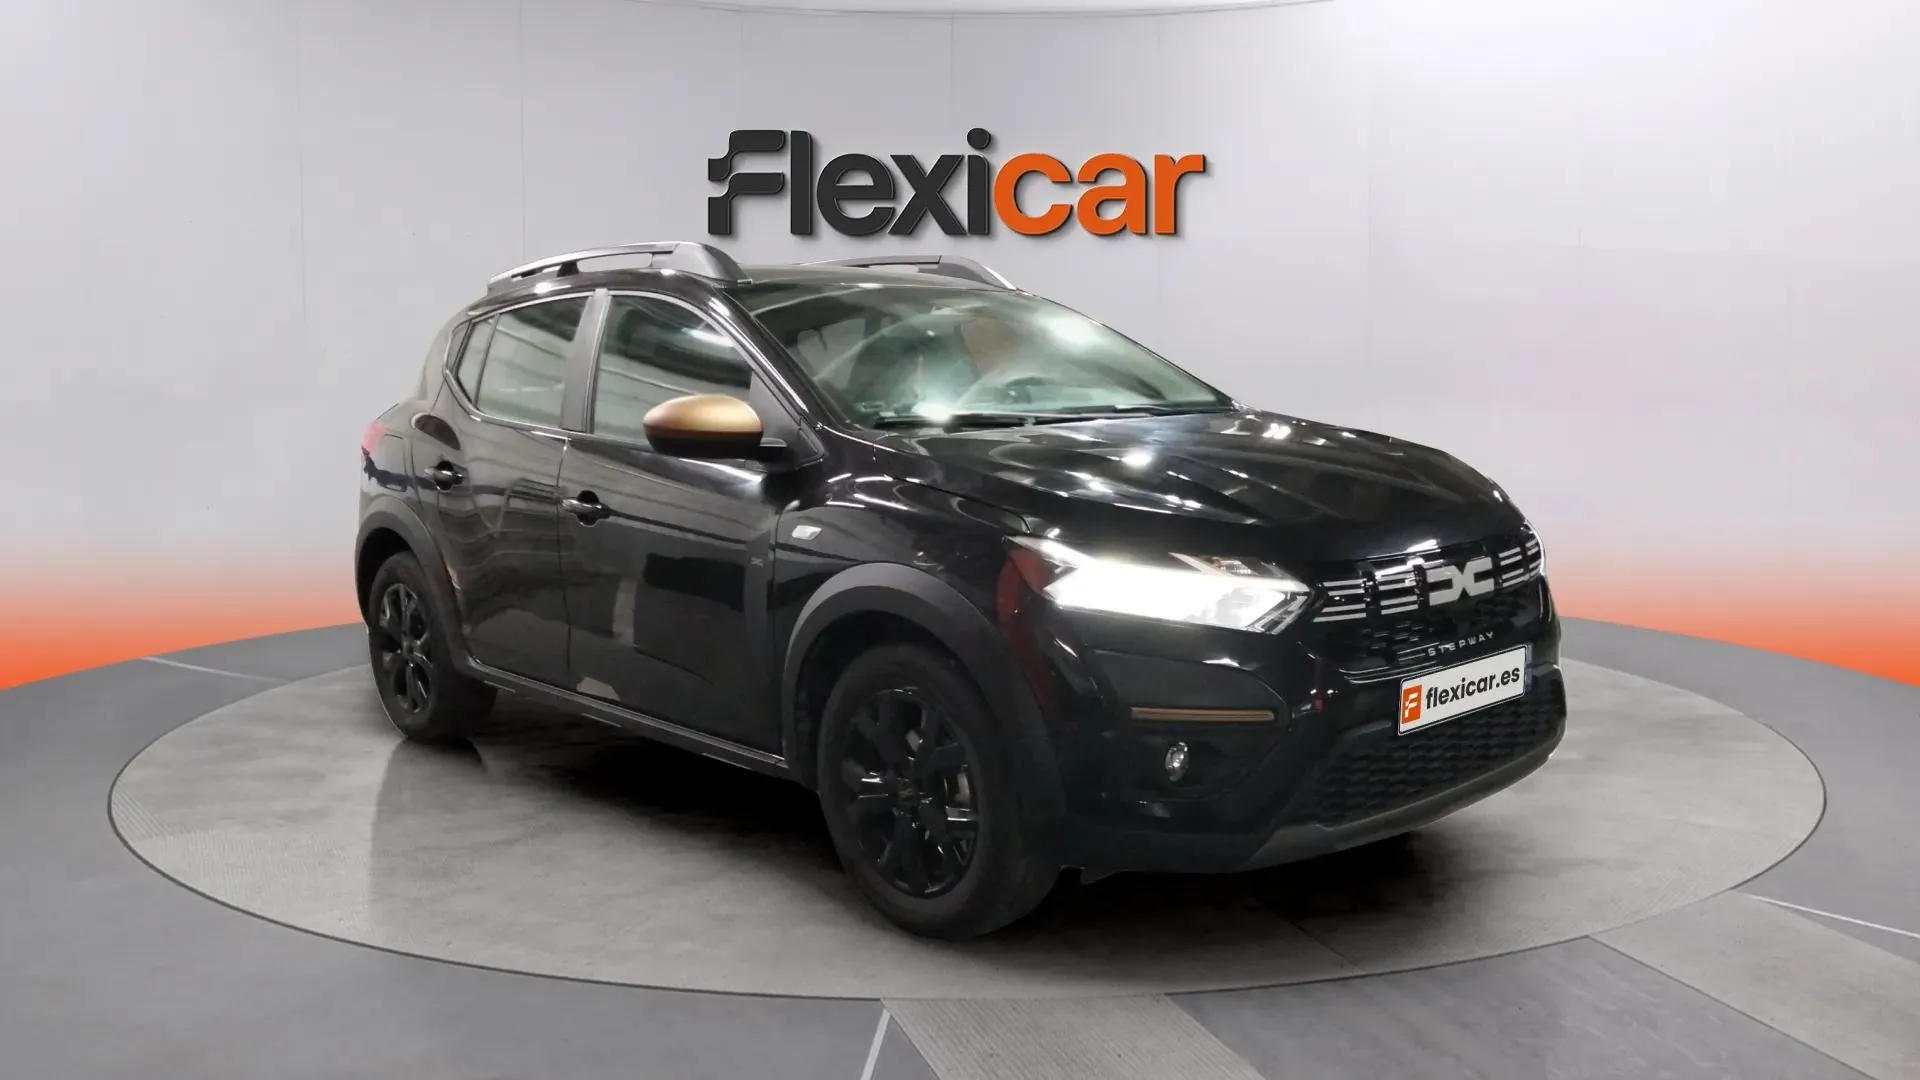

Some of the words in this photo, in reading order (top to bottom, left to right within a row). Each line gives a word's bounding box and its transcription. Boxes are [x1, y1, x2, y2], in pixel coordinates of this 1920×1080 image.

[708, 128, 1205, 236] Flexicar
[1427, 631, 1494, 657] STEPWAY
[1425, 667, 1520, 709] flexicar.es
